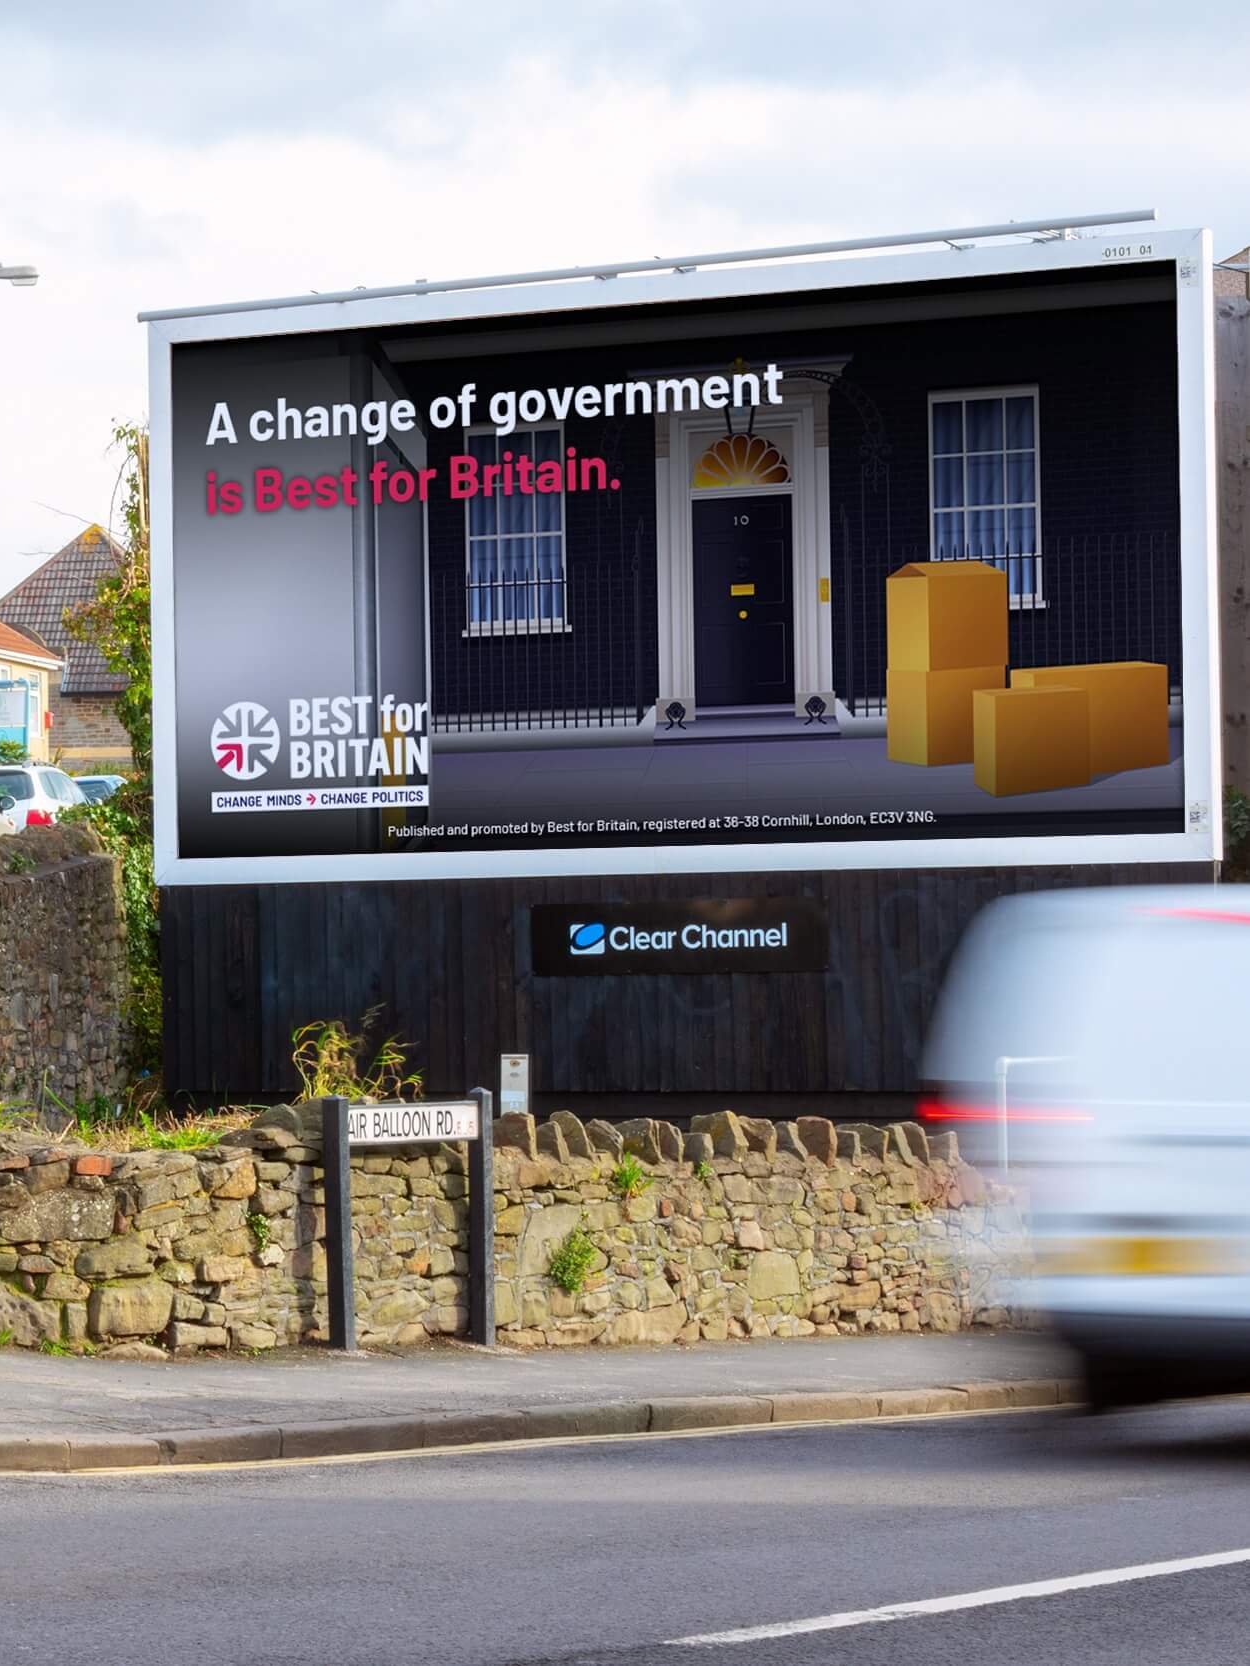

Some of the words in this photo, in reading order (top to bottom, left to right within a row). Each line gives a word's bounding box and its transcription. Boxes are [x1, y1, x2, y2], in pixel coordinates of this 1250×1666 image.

[205, 402, 238, 446] A
[249, 397, 416, 446] change
[429, 383, 477, 429] of
[488, 363, 784, 436] government
[206, 470, 244, 515] is
[254, 465, 358, 513] Best
[369, 460, 437, 505] for
[449, 447, 621, 499] Britain.
[733, 515, 749, 526] 10
[289, 695, 372, 737] BEST
[380, 694, 428, 733] for
[290, 736, 429, 779] BRITAIN
[216, 795, 262, 808] CHANGE
[266, 794, 302, 806] MINDS
[320, 792, 367, 805] CHANGE
[372, 790, 424, 803] POLITICS
[388, 825, 444, 838] Published
[447, 824, 468, 836] and
[471, 822, 528, 838] promoted
[531, 822, 545, 837] by
[547, 821, 575, 834] Best
[577, 820, 596, 833] for
[597, 819, 641, 833] Britain,
[643, 817, 706, 833] registered
[708, 818, 721, 829] at
[761, 814, 813, 828] Cornhill,
[815, 813, 866, 827] London,
[869, 811, 904, 824] EC3V
[906, 810, 937, 824] 3NG.
[609, 925, 677, 951] Clear
[681, 922, 788, 949] Channel
[348, 1113, 367, 1138] AIR
[373, 1110, 431, 1138] BALLOON
